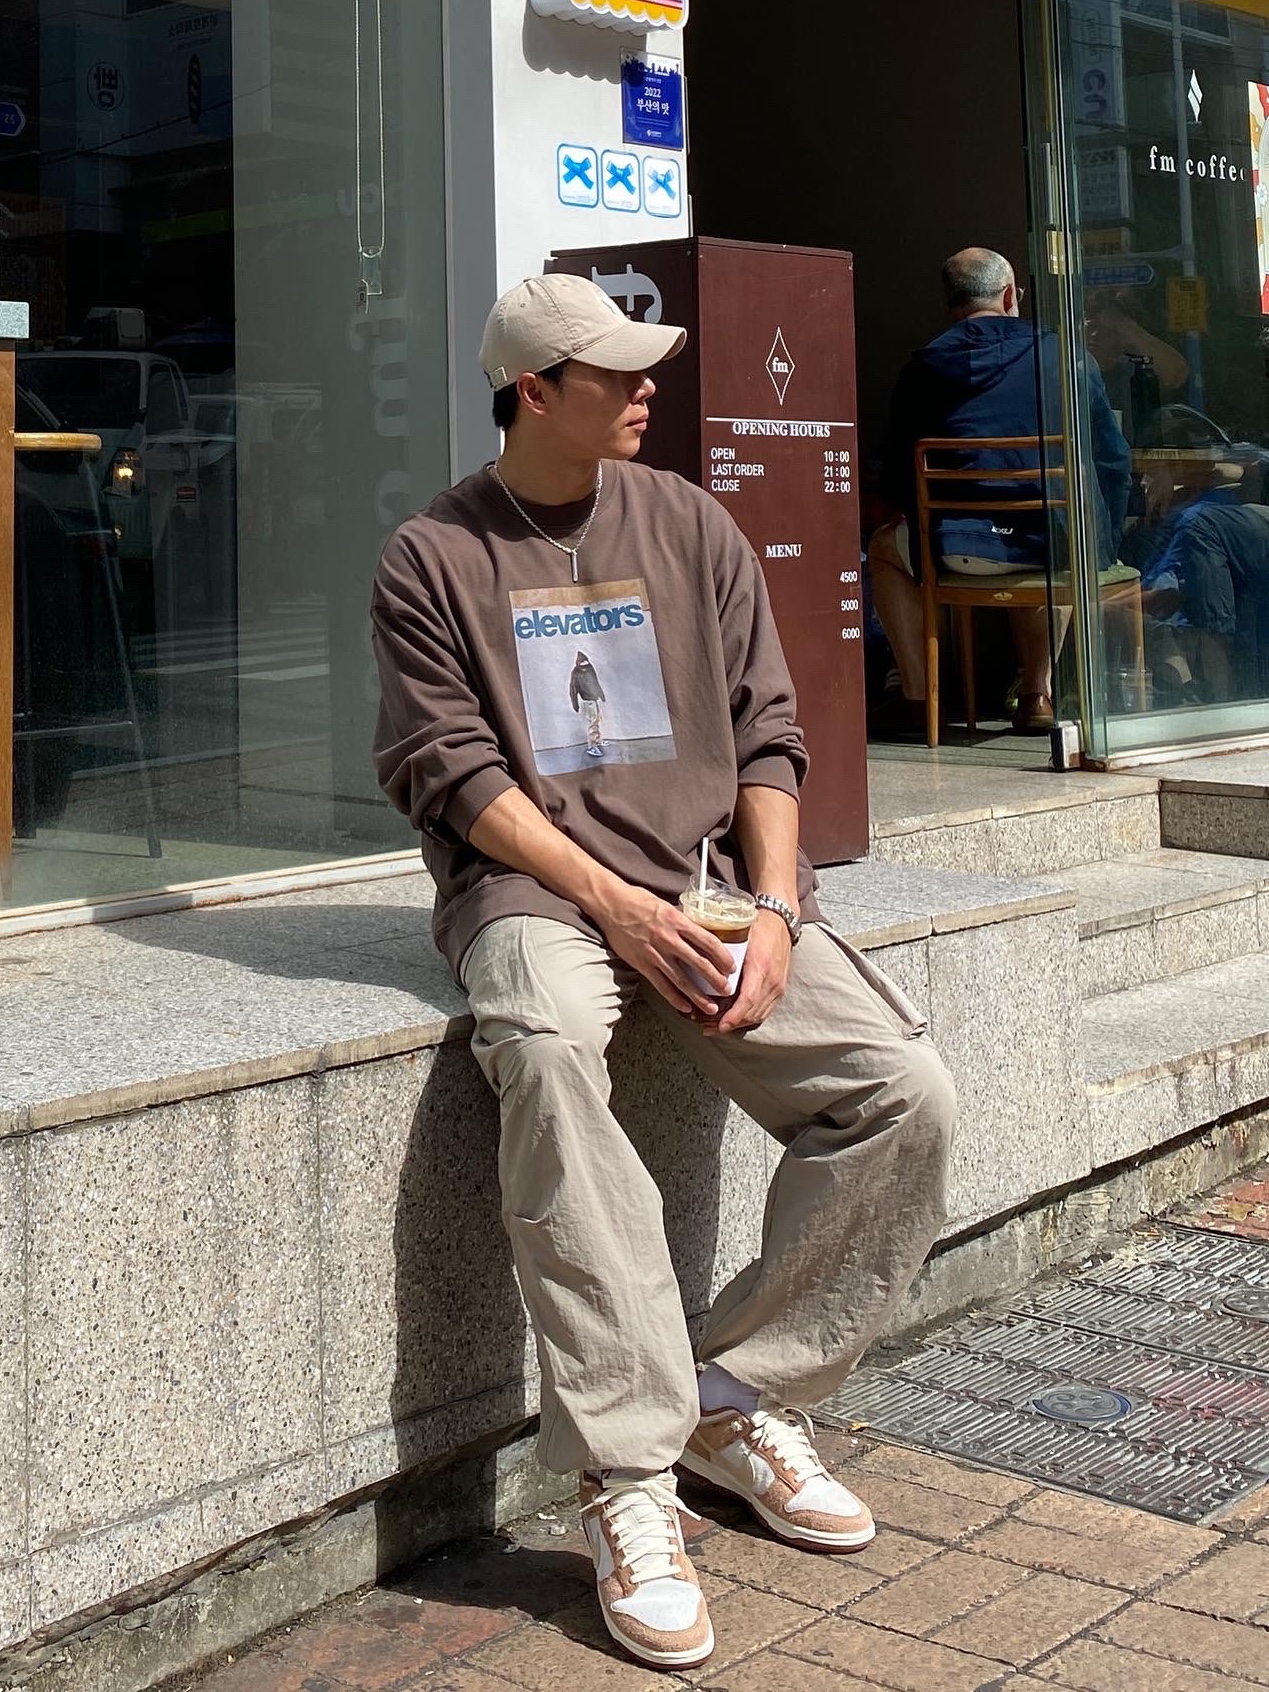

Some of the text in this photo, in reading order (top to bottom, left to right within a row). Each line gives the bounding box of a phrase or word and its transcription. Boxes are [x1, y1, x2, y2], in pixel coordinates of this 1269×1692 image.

[644, 86, 661, 98] 2022
[636, 98, 670, 116] 부산의 맛
[1149, 145, 1176, 173] fm
[1185, 154, 1245, 182] coffe
[591, 263, 663, 324] f
[772, 356, 789, 373] fm
[732, 421, 831, 438] OPENING HOURS
[710, 447, 736, 460] OPEN
[823, 450, 850, 463] 10:00
[711, 463, 765, 476] LAST ORDER
[824, 465, 851, 478] 21:00
[711, 479, 741, 492] CLOSE
[824, 481, 851, 493] 22:00
[765, 543, 803, 558] MENU
[839, 570, 858, 583] 4500
[840, 598, 859, 612] 5000
[515, 604, 645, 639] elevators
[841, 627, 861, 640] 6000
